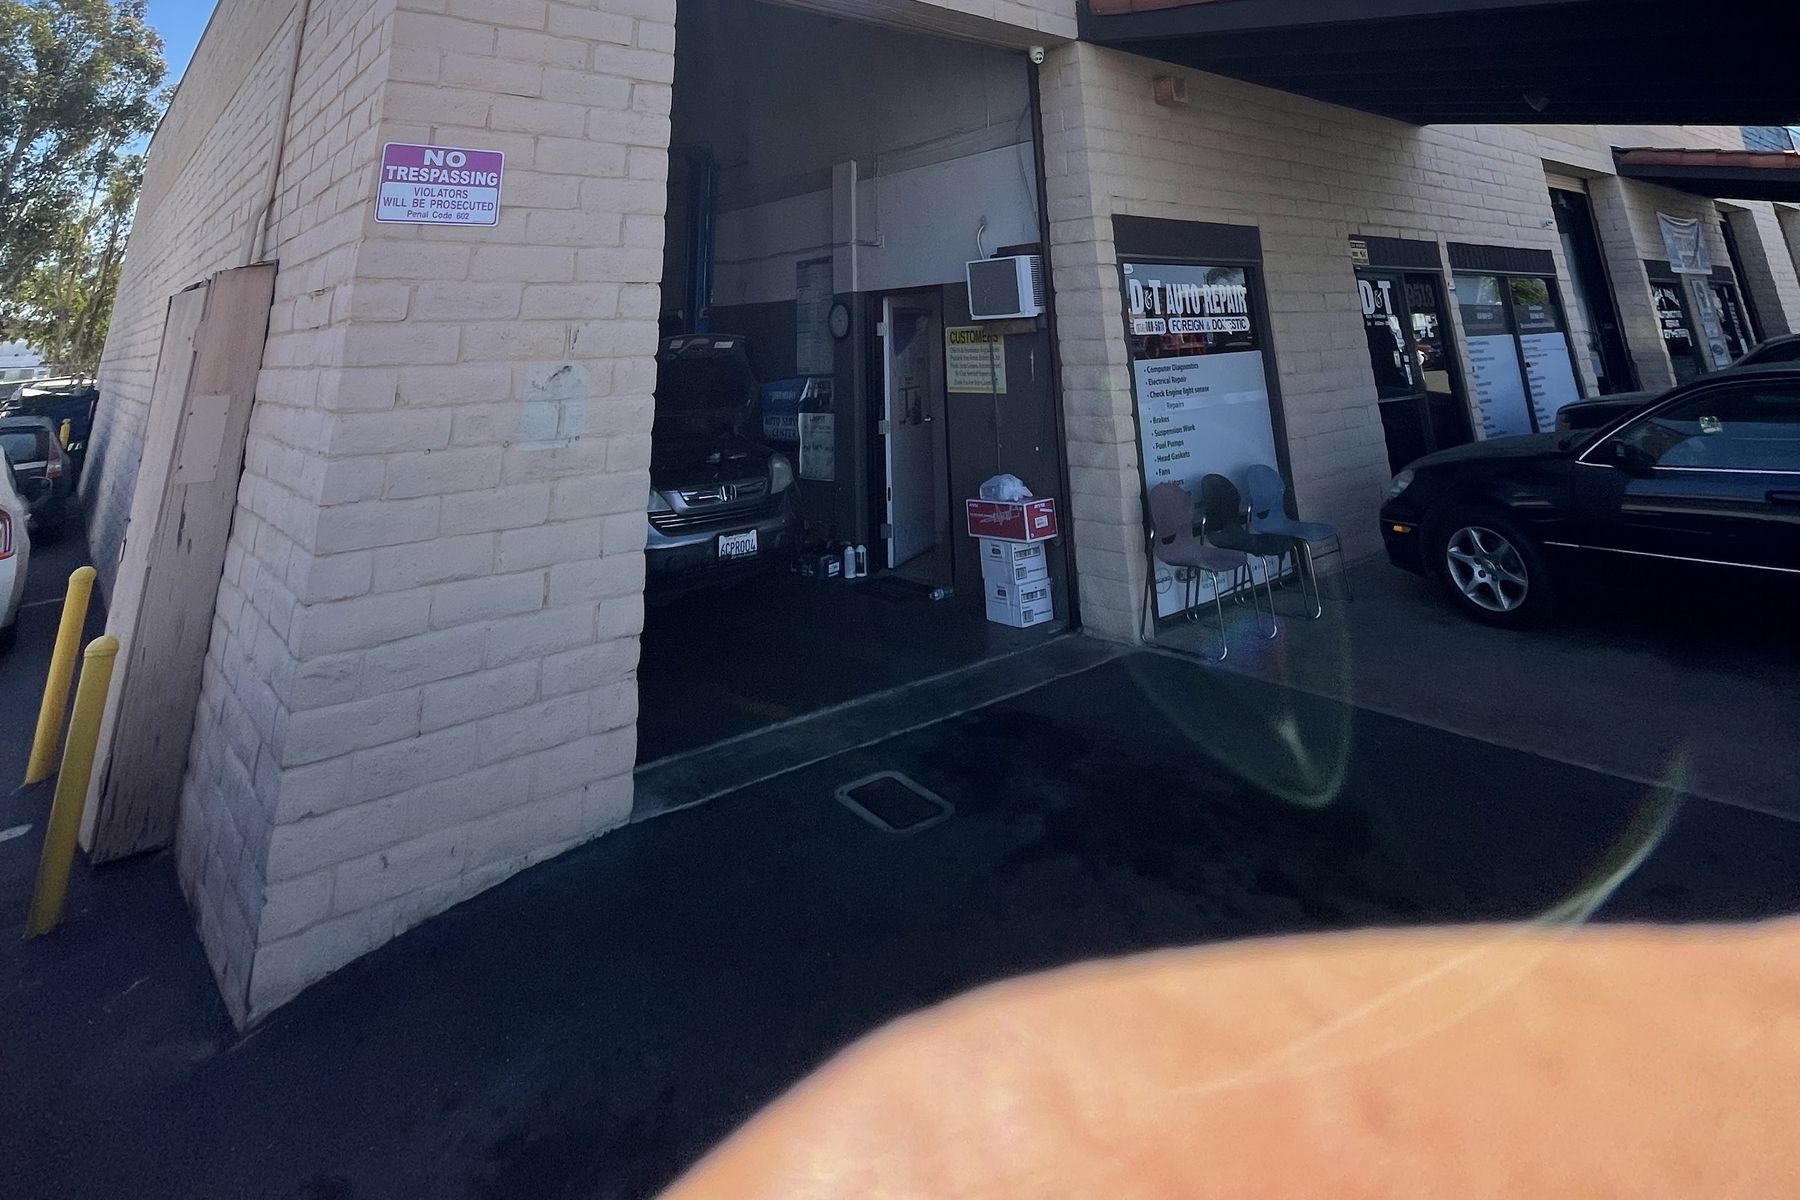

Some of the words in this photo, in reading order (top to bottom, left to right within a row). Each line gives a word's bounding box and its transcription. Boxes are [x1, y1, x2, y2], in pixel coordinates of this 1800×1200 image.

[423, 149, 467, 168] NO
[386, 165, 498, 186] TRESPASSING
[414, 187, 469, 199] VIOLATORS
[383, 197, 407, 207] WILL
[412, 198, 425, 208] BE
[430, 199, 494, 211] PROSECUTED
[407, 210, 429, 218] Penal
[432, 210, 452, 219] Code
[456, 212, 470, 220] 602
[1165, 283, 1200, 314] AUTO
[1203, 284, 1248, 313] REPAIR
[1172, 319, 1204, 332] FOREIGN
[1212, 318, 1246, 331] DOSTIC
[1147, 365, 1171, 373] Computer
[1148, 376, 1171, 386] Electrical
[1171, 376, 1187, 384] Repair
[1150, 390, 1165, 398] Check
[1166, 388, 1182, 397] Engine
[1153, 415, 1169, 424] Brakes
[1156, 440, 1167, 450] Fuel
[1167, 439, 1184, 448] Pumps
[1157, 453, 1170, 462] Head
[1171, 450, 1191, 460] Gaskets
[1159, 467, 1170, 476] Fans
